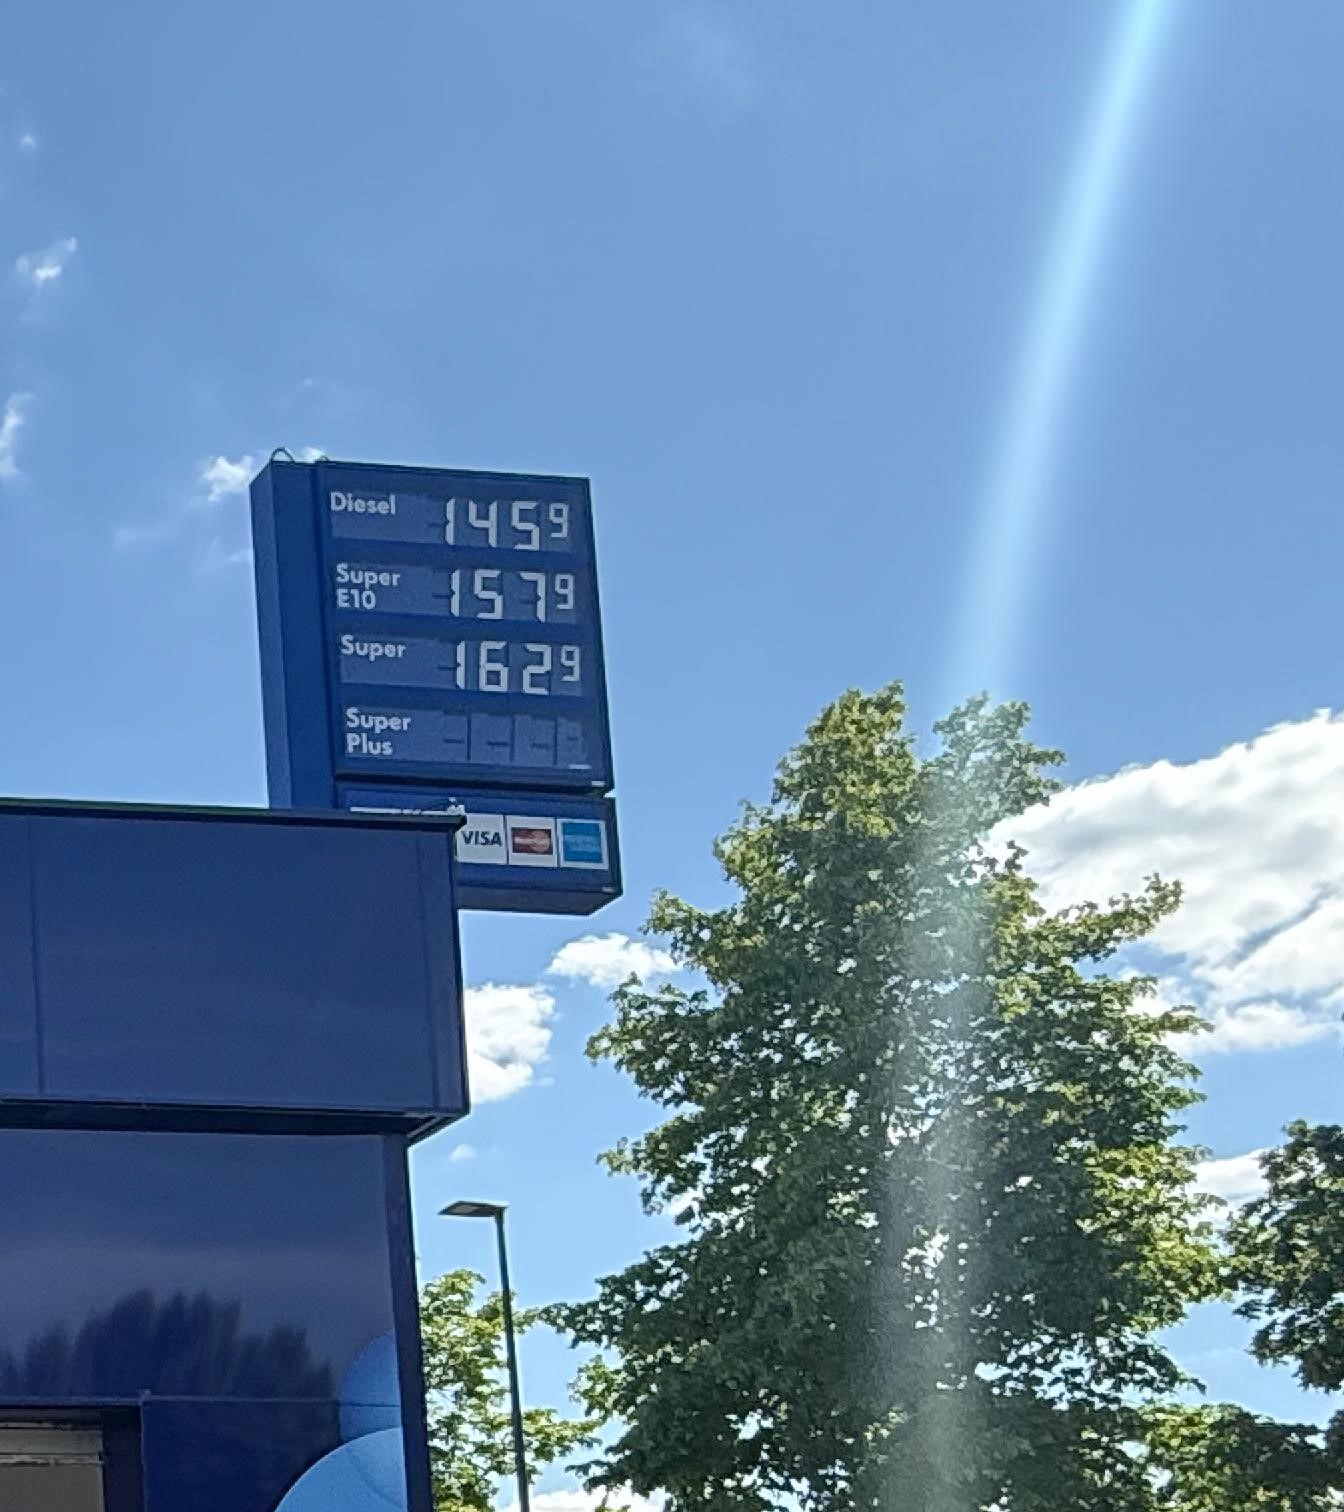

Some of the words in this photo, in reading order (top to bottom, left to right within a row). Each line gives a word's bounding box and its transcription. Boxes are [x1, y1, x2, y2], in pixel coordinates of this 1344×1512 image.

[329, 491, 397, 515] Diesel
[335, 563, 400, 588] Super
[336, 588, 376, 609] E10
[340, 634, 406, 660] Super
[345, 707, 411, 733] Super
[345, 732, 394, 756] Plus
[461, 829, 503, 847] VISA
